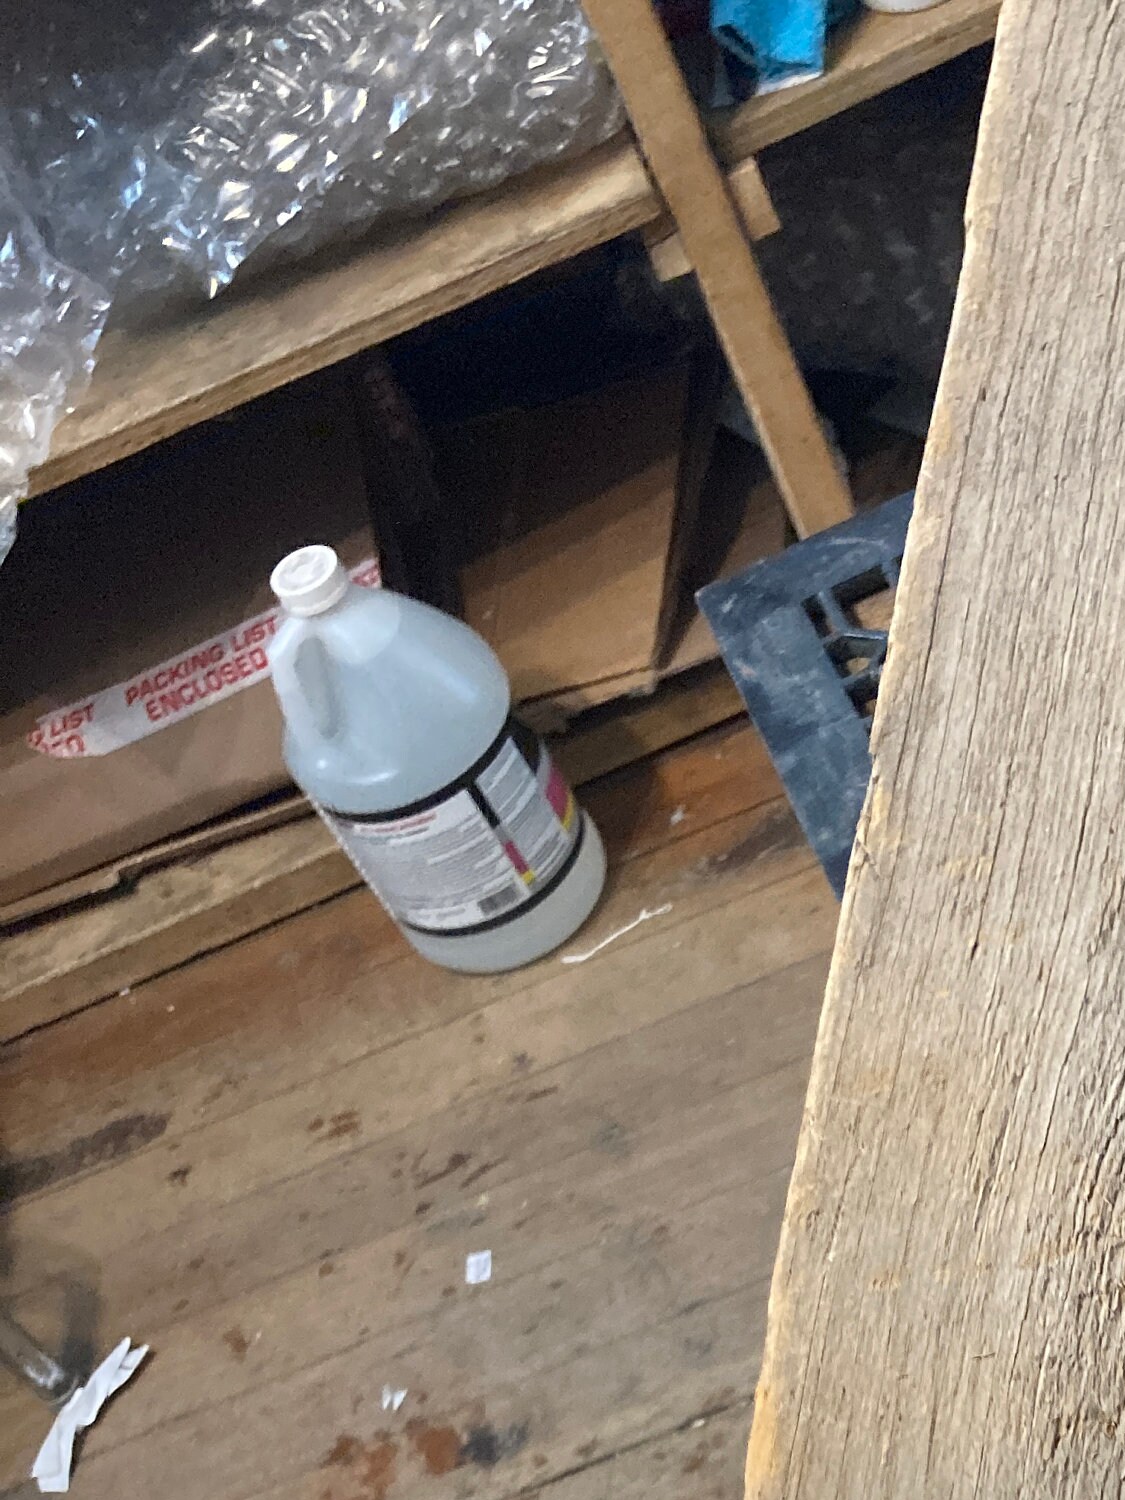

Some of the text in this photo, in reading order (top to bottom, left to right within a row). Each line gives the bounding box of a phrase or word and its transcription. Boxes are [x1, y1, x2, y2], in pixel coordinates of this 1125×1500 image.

[124, 615, 278, 707] PACKING LIST
[145, 647, 269, 722] ENCLOSED
[50, 702, 95, 738] LIST
